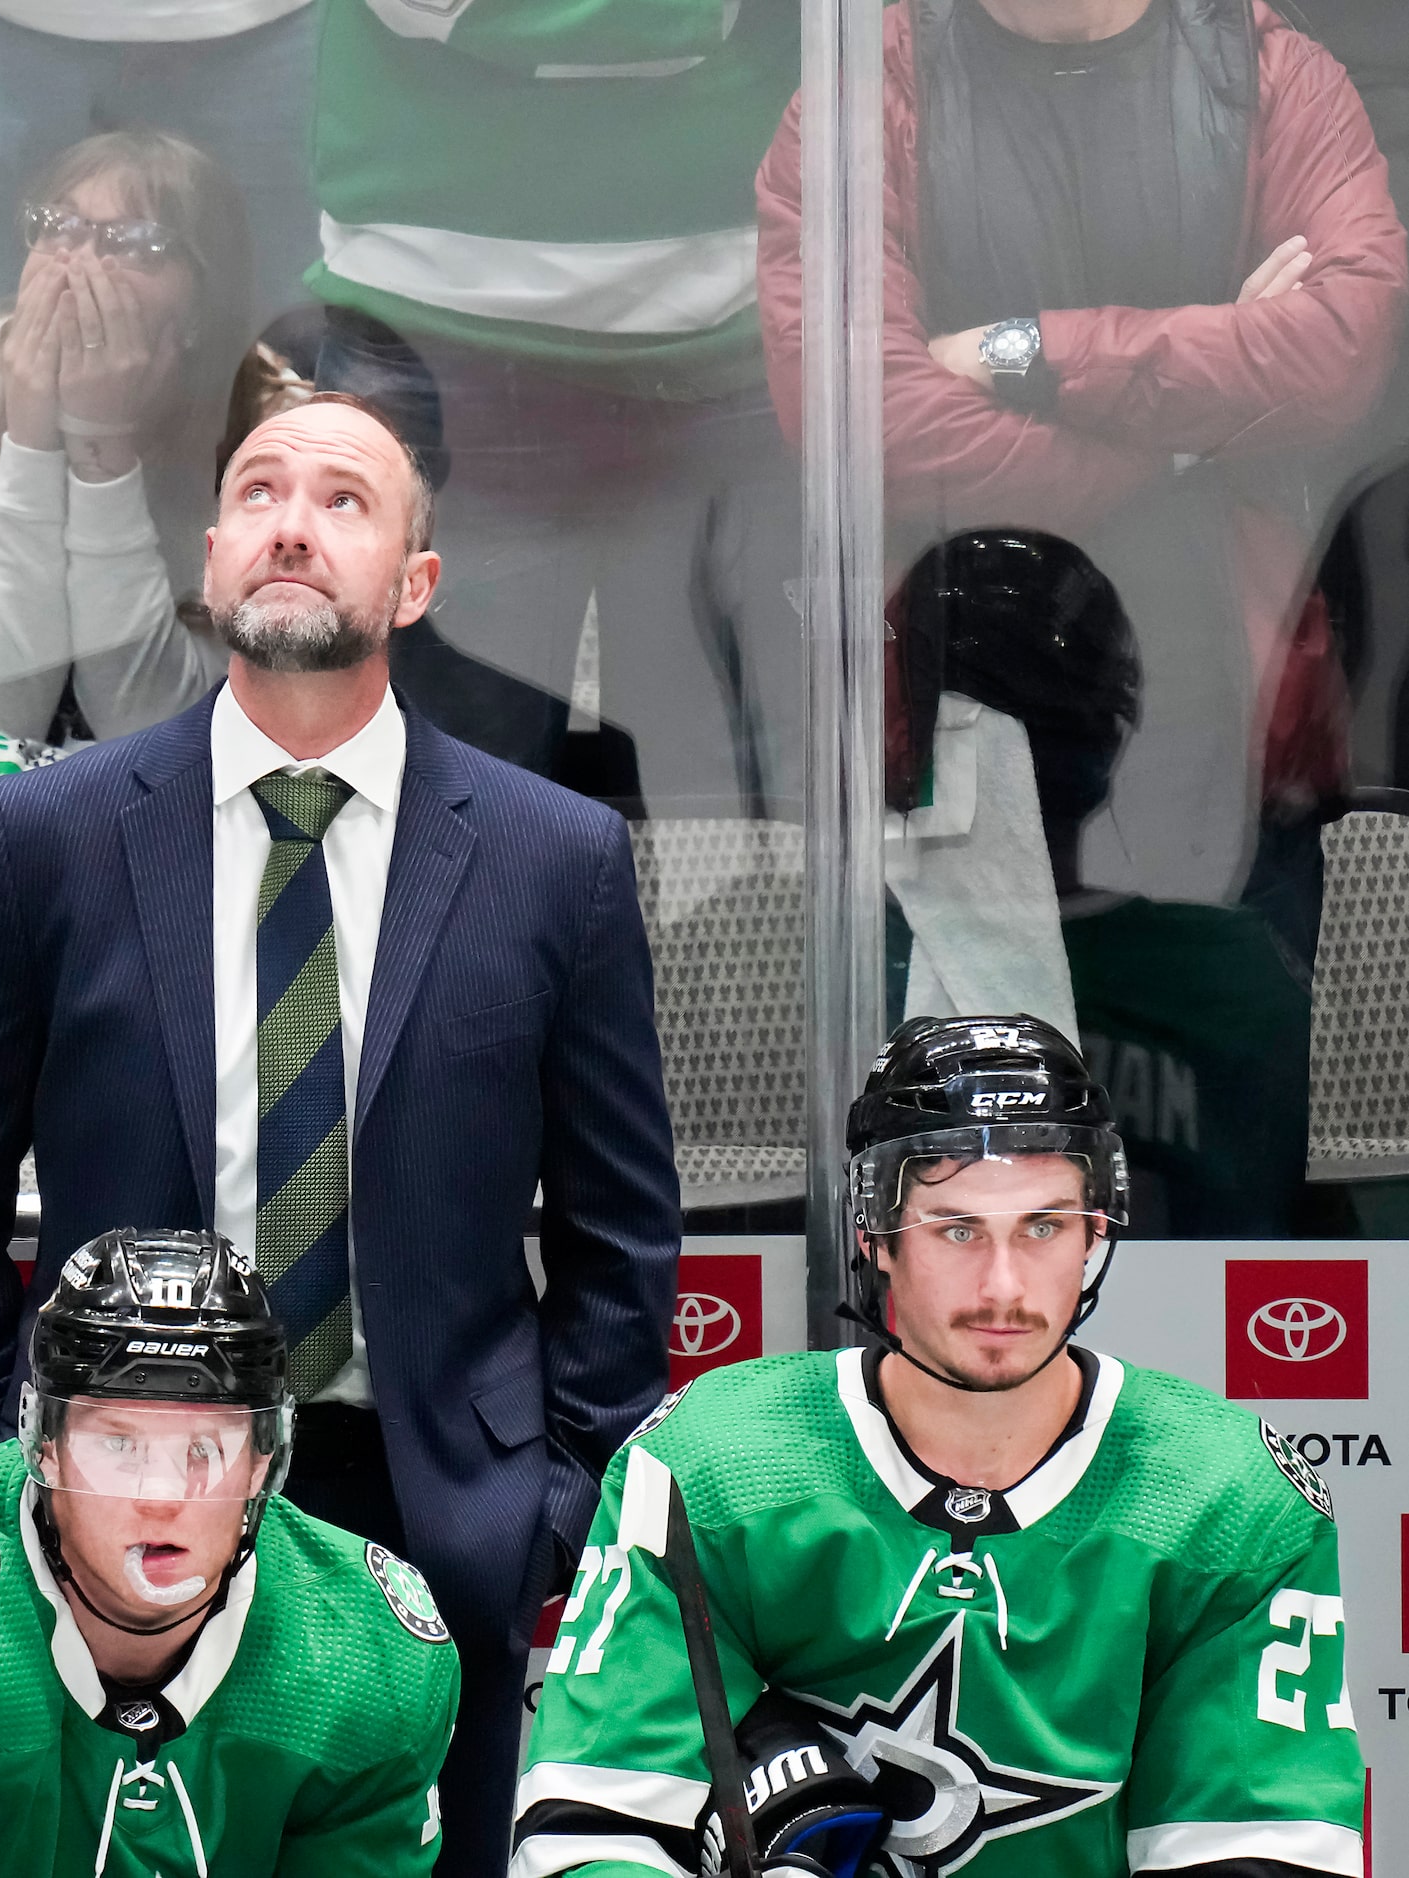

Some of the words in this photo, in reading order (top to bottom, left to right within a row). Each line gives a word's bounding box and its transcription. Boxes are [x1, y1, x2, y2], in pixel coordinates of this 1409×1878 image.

[970, 1028, 1020, 1050] 27
[970, 1092, 1047, 1109] CCM
[149, 1277, 192, 1309] 10
[125, 1340, 210, 1358] BAUER
[545, 1544, 632, 1676] 27
